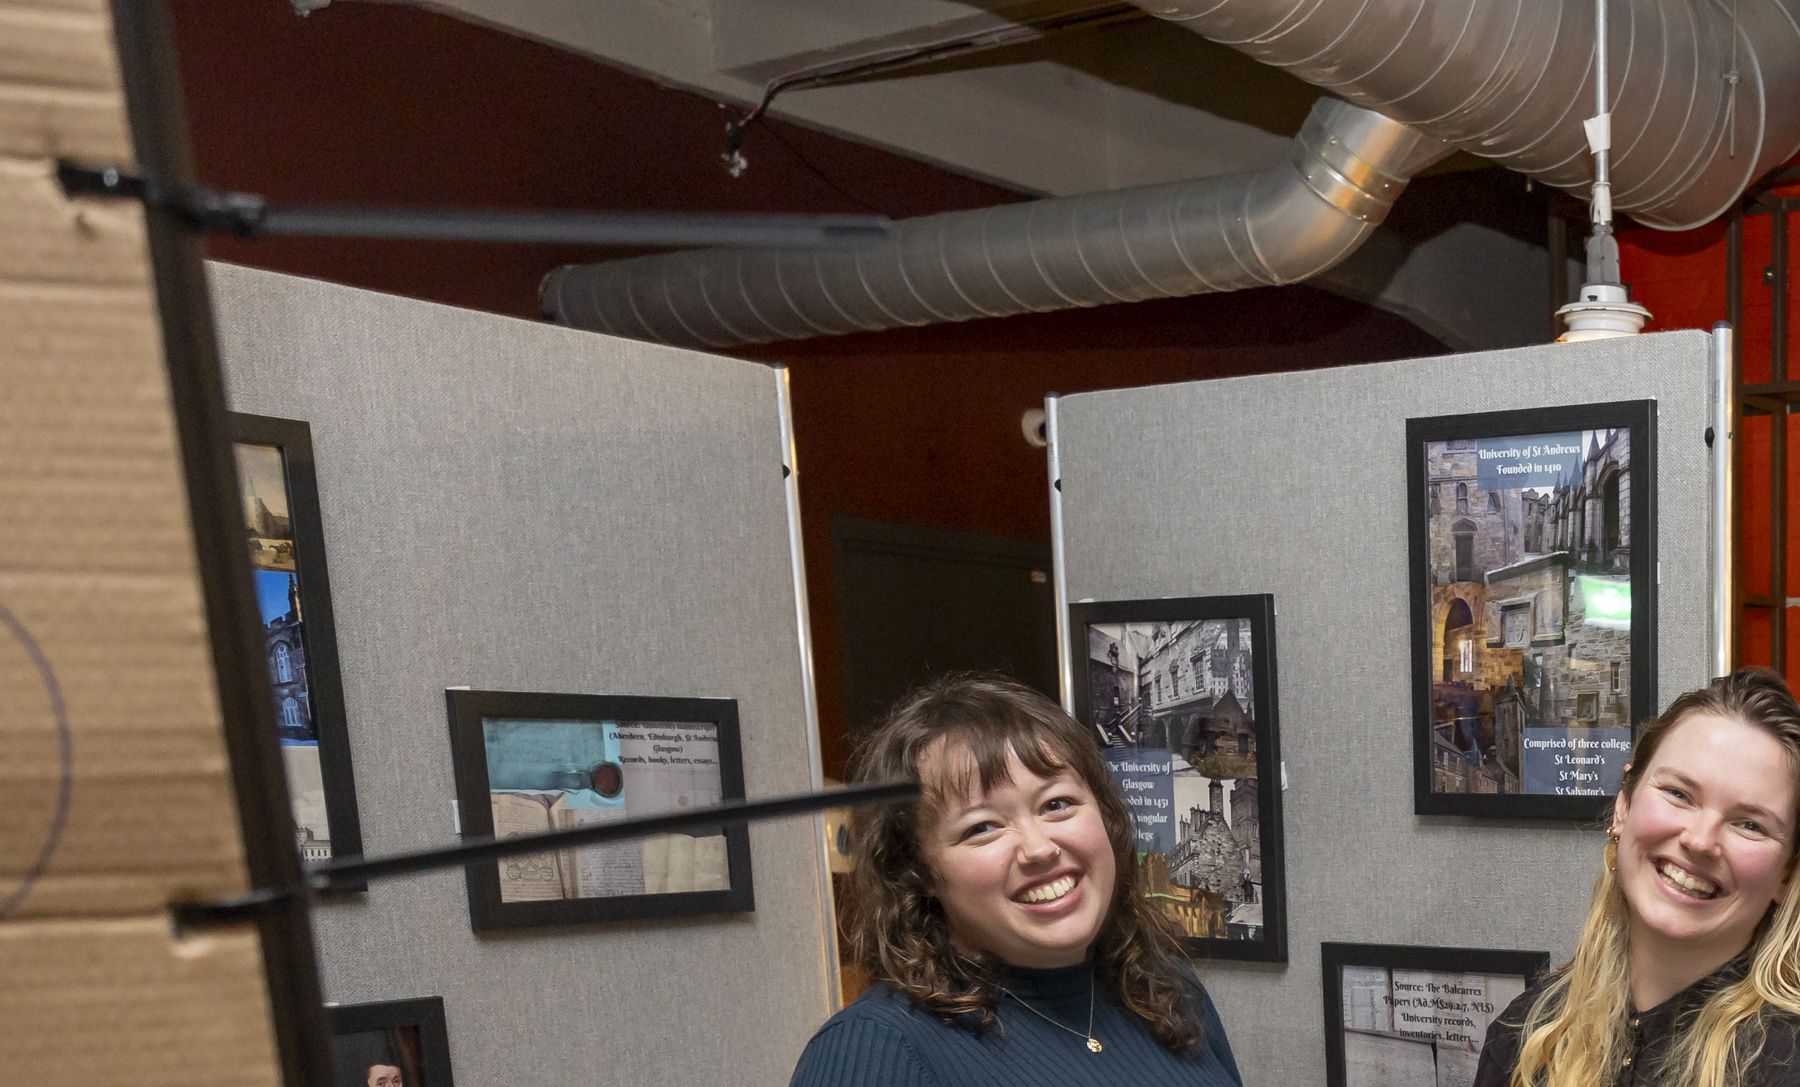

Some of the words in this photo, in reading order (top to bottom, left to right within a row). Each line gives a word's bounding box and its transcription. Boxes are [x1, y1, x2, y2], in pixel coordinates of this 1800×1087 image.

[1478, 447, 1521, 460] University
[1523, 446, 1532, 459] of
[1532, 445, 1541, 457] St
[1542, 444, 1580, 456] Andrews
[1496, 463, 1532, 475] Founded
[1534, 463, 1542, 473] in
[1544, 464, 1562, 474] 1410
[653, 744, 683, 754] (Glasgow)
[1524, 738, 1566, 750] Comprised
[1568, 738, 1577, 750] of
[1578, 738, 1599, 750] three
[1601, 738, 1631, 751] college
[618, 755, 647, 764] Records,
[648, 756, 669, 764] books,
[670, 756, 693, 764] letters,
[1554, 754, 1564, 766] St
[1565, 754, 1605, 766] Leonard's
[1120, 761, 1160, 774] University
[1162, 761, 1171, 774] of
[1559, 771, 1568, 781] St
[1569, 769, 1599, 782] Mary's
[1122, 779, 1155, 791] Glasgow
[1555, 786, 1565, 796] St
[1565, 786, 1605, 796] Salvator's
[1144, 796, 1152, 806] in
[1153, 798, 1169, 808] 1451
[1137, 813, 1168, 825] singular
[1394, 981, 1424, 992] Source:
[1425, 983, 1441, 993] The
[1442, 984, 1482, 996] Balcarres
[1383, 995, 1410, 1008] Papers
[1470, 1002, 1494, 1014] NLS)
[1401, 1012, 1442, 1026] University
[1444, 1016, 1476, 1028] records,
[1399, 1028, 1445, 1041] inventories,
[1446, 1031, 1479, 1043] letters...
